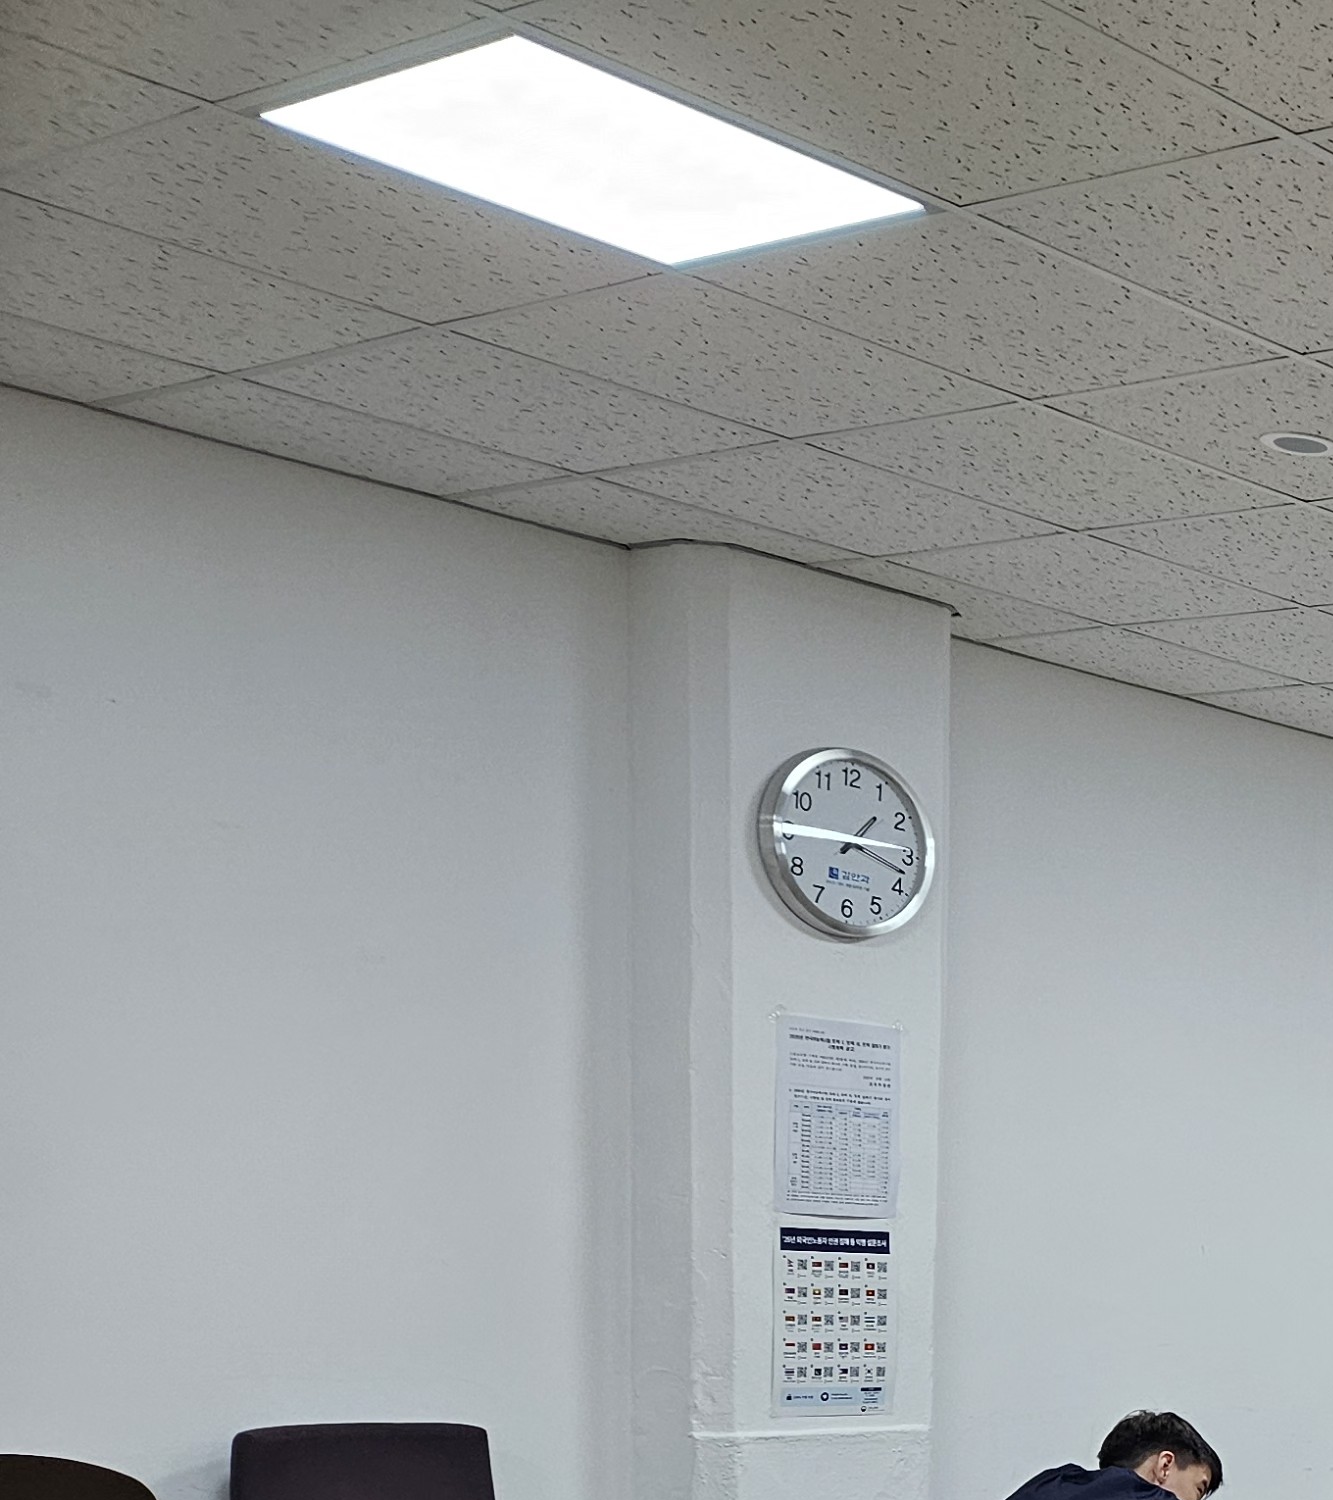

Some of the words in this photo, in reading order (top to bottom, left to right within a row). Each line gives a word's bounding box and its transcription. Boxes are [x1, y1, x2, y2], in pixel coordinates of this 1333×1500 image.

[815, 770, 831, 791] 11
[842, 767, 862, 789] 12
[793, 790, 812, 811] 10
[876, 783, 883, 802] 1
[894, 812, 906, 831] 2
[790, 856, 804, 876] 8
[902, 847, 914, 867] 3
[813, 884, 826, 904] 7
[891, 877, 904, 896] 4
[840, 898, 854, 918] 6
[870, 896, 882, 915] 5
